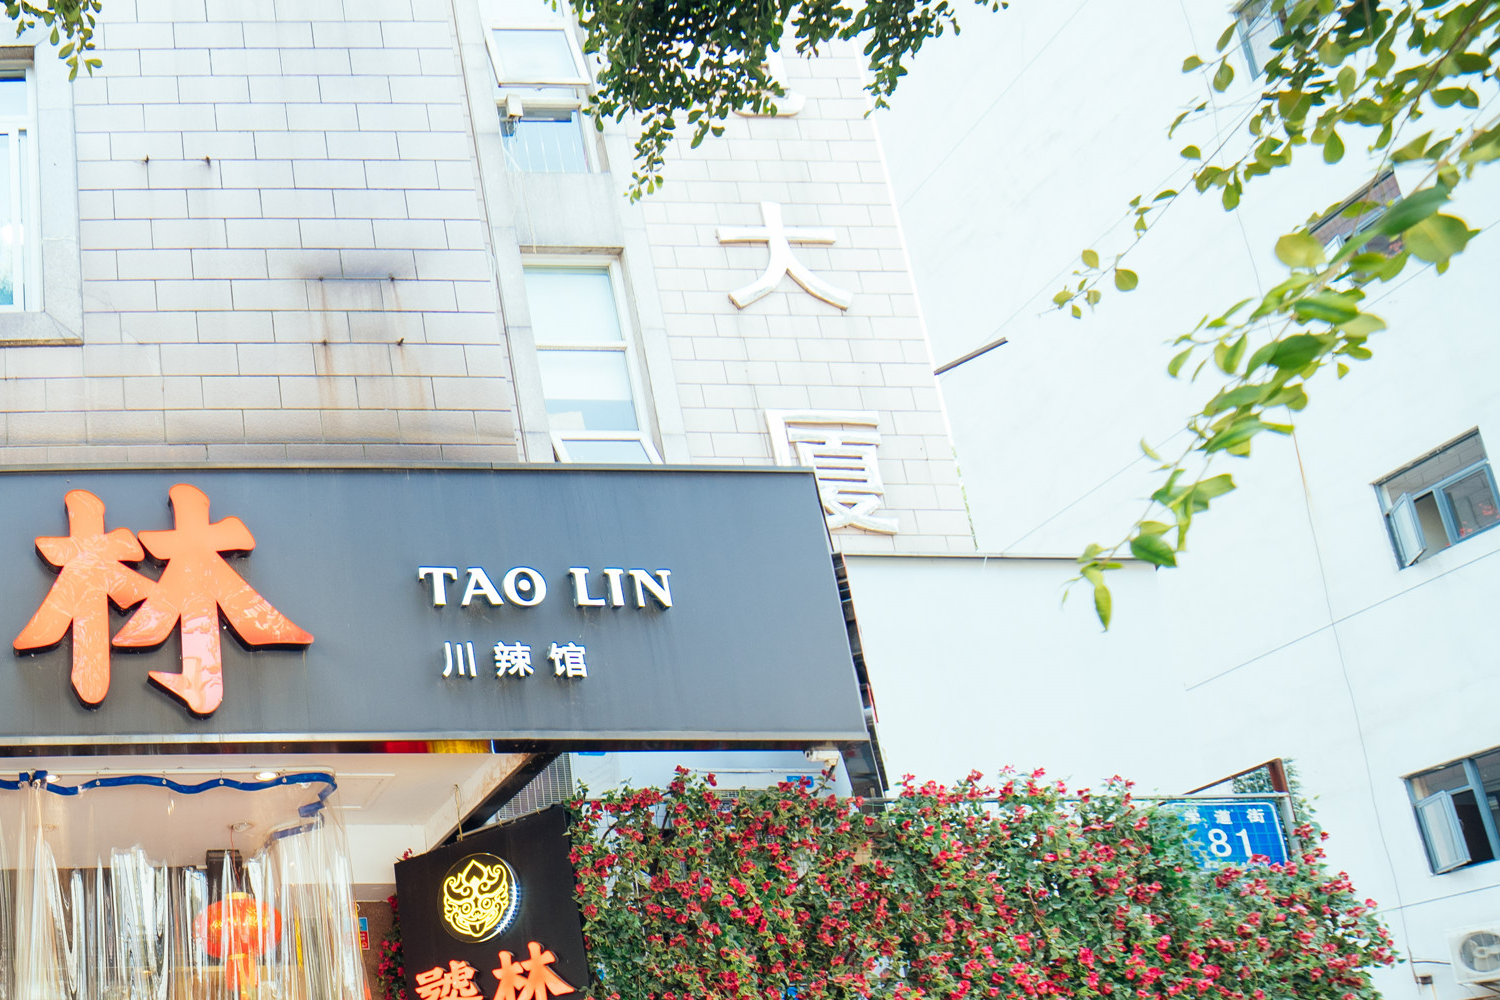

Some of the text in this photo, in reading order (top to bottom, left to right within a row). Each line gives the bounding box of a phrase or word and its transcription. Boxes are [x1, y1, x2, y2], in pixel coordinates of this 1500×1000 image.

[13, 484, 314, 715] 林
[418, 566, 673, 609] TAO LIN
[442, 641, 588, 678] 川辣馆
[1208, 828, 1254, 858] 81
